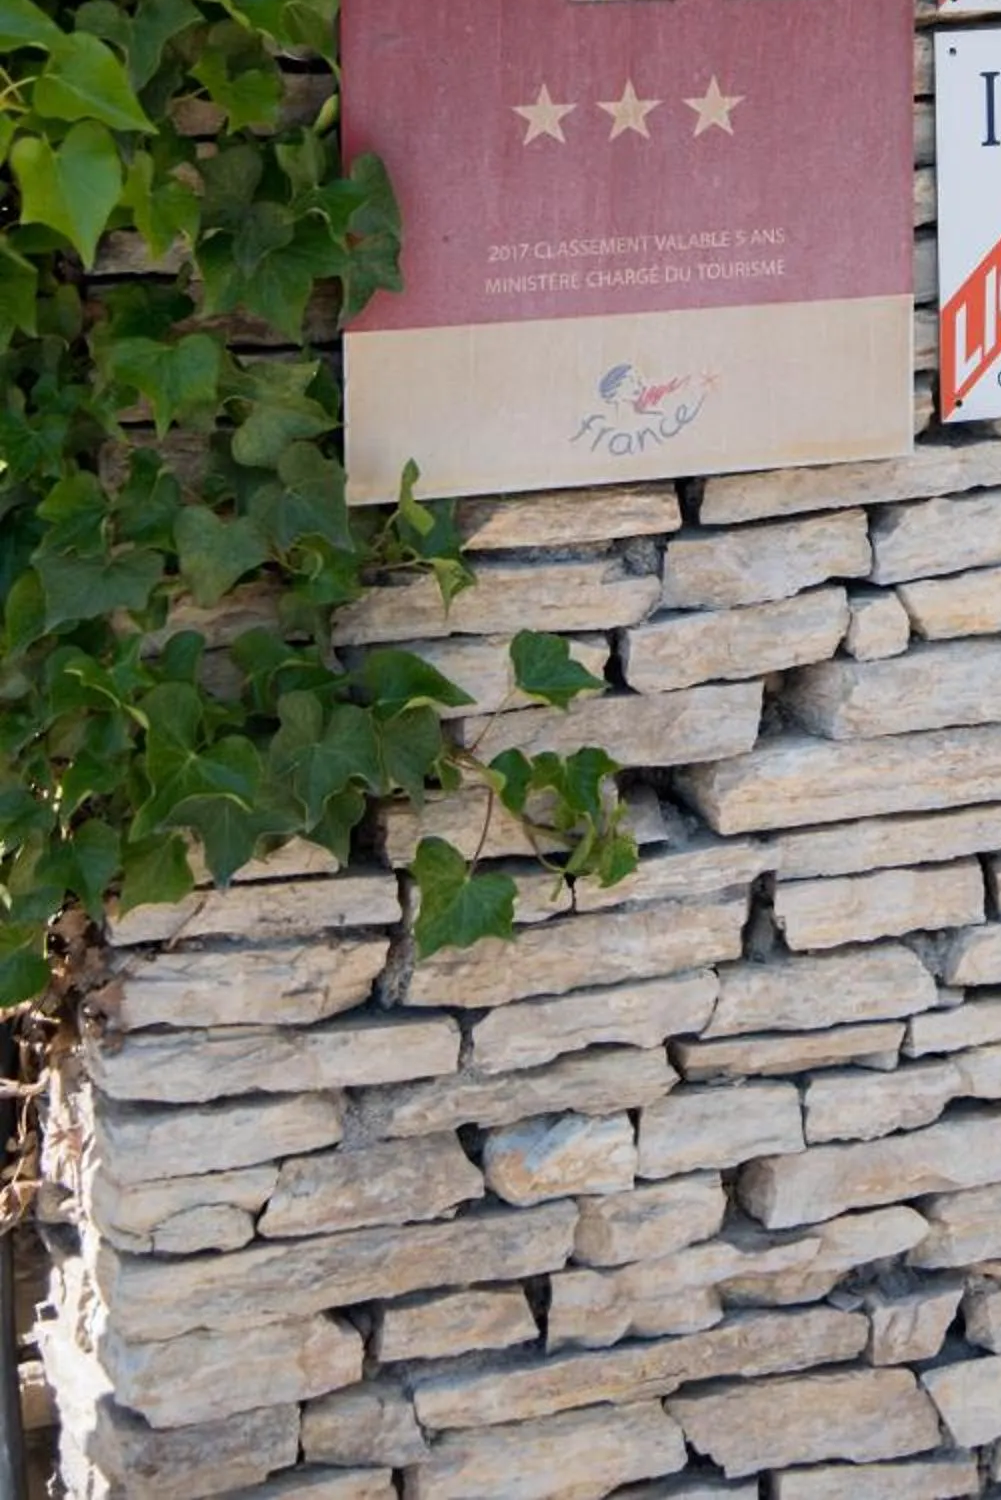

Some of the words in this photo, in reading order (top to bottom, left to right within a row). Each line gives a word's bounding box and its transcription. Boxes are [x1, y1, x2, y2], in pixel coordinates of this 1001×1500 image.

[488, 243, 529, 262] 2017
[534, 236, 648, 260] CLASSEMENT
[655, 231, 731, 251] VALABLE
[751, 227, 785, 245] ANS
[666, 265, 691, 282] DU
[698, 259, 785, 280] TOURISME
